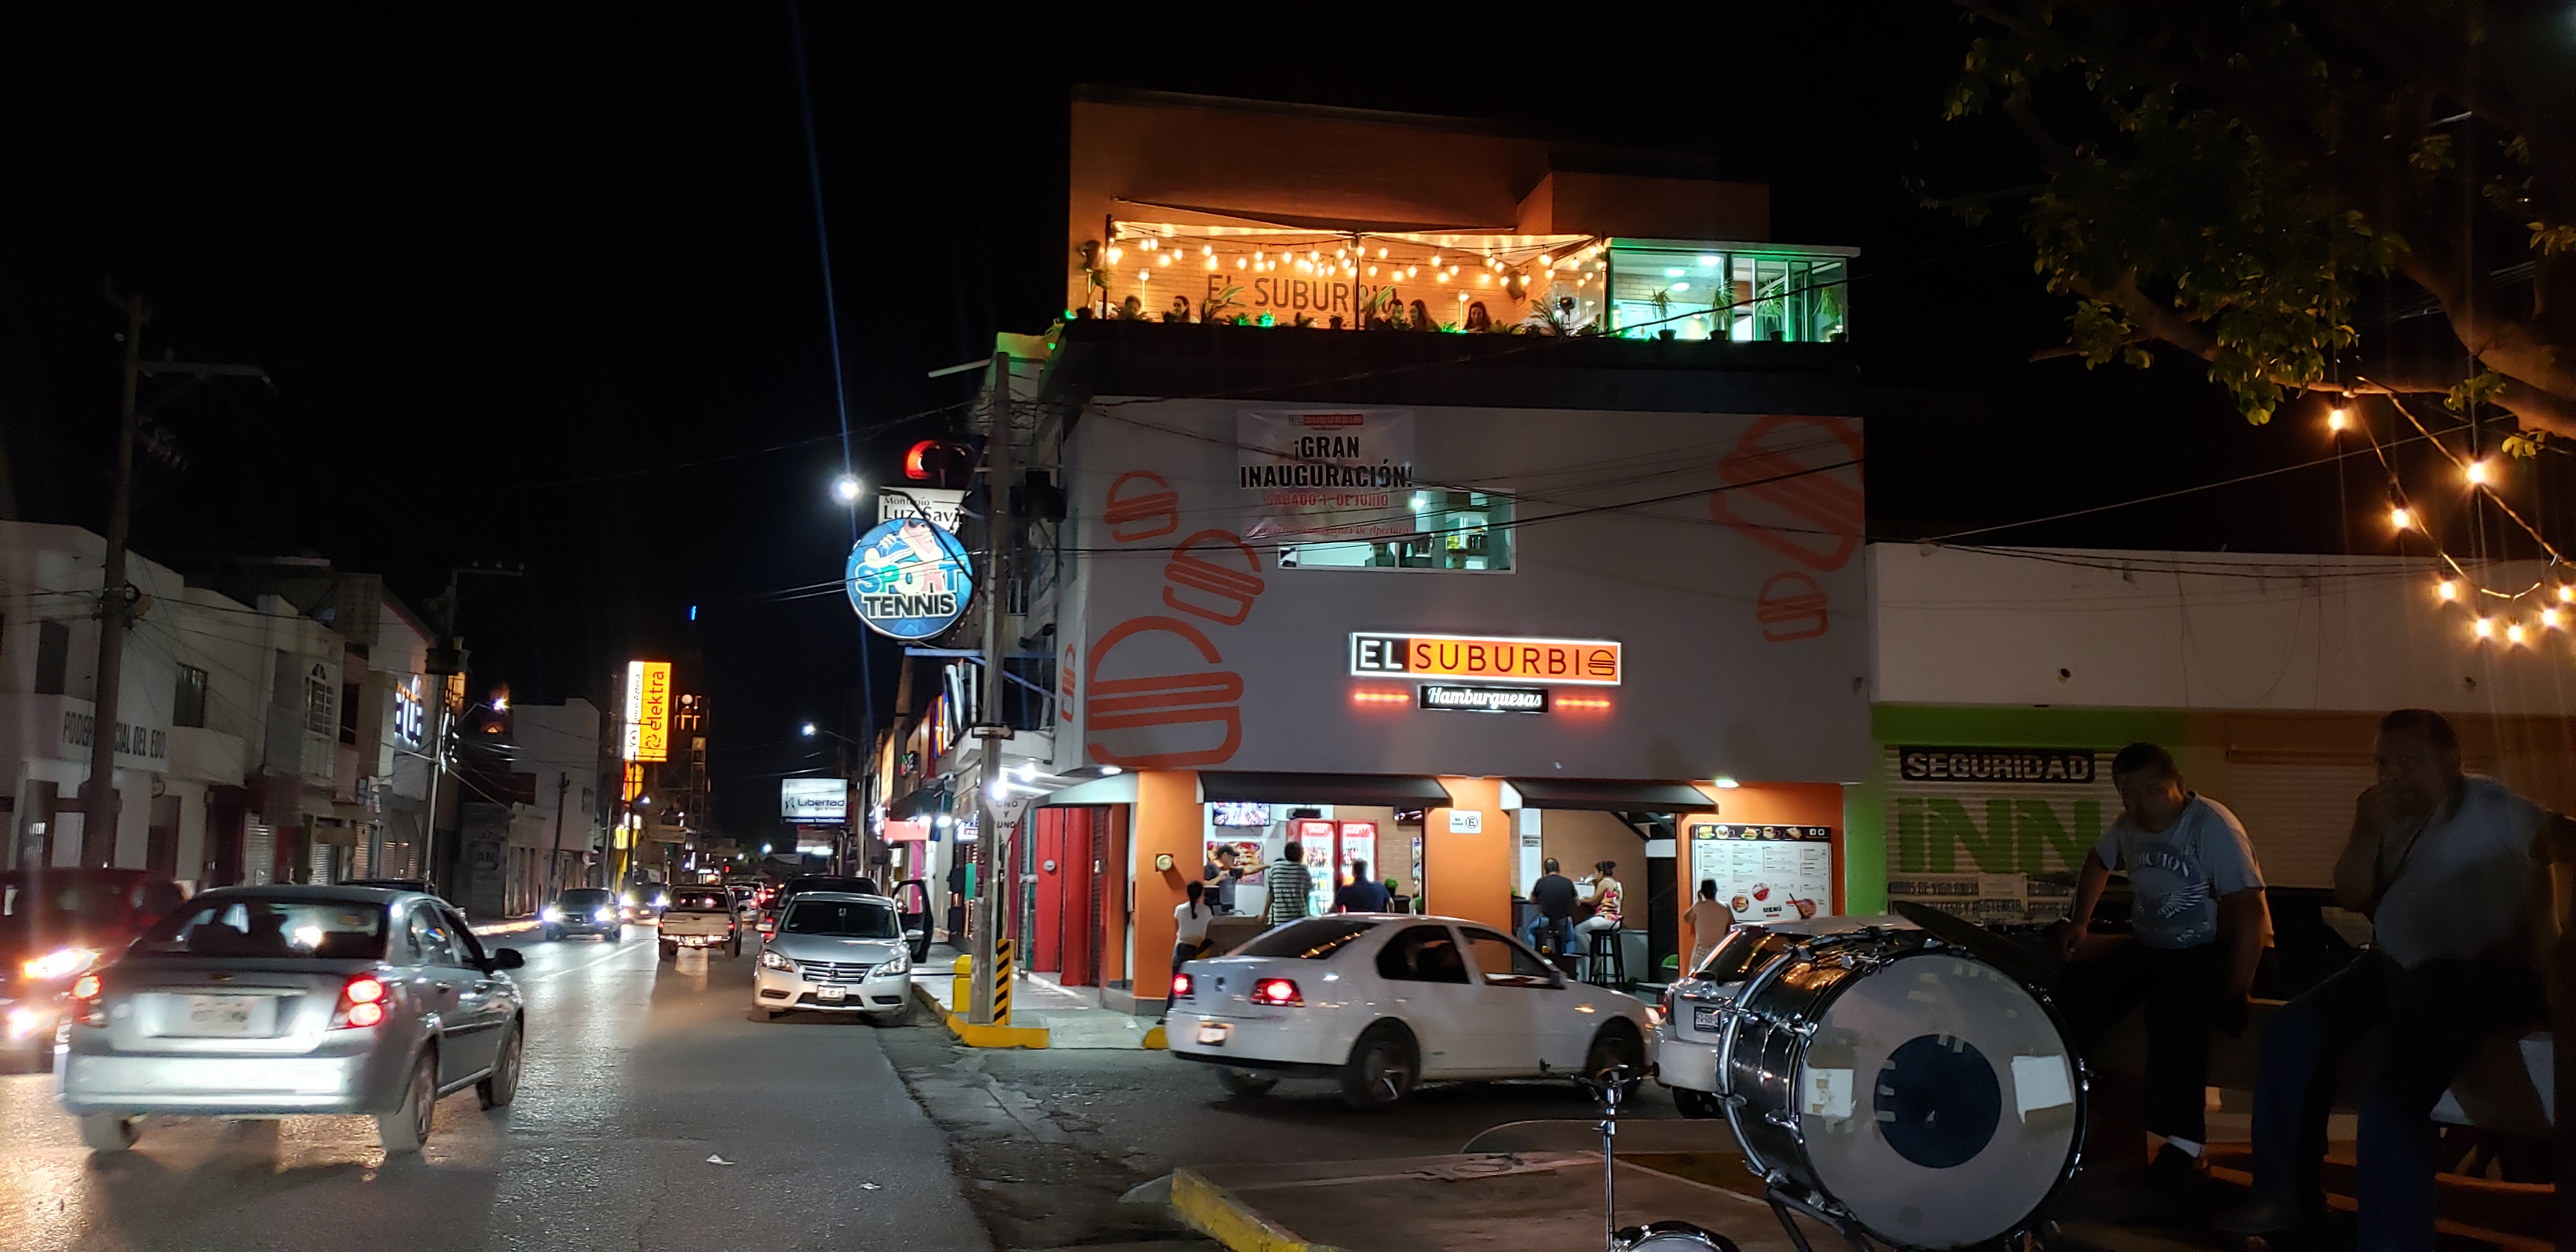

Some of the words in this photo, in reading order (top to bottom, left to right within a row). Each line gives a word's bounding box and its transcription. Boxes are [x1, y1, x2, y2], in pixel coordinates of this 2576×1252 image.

[1208, 274, 1236, 304] EL
[1294, 436, 1359, 461] ¡GRAN
[1241, 459, 1412, 488] INAUGURACIÓN!
[884, 496, 930, 506] Montpío
[1267, 492, 1316, 506] SÁBADO
[1337, 494, 1350, 506] DE
[1355, 494, 1388, 506] JUNIO
[884, 505, 916, 519] Luz
[855, 561, 964, 594] SPORT
[862, 593, 957, 618] TENNIS
[1360, 640, 1404, 670] EL
[646, 671, 664, 731] elektra
[1427, 687, 1542, 710] Hamburguesas
[1906, 752, 2089, 779] SEGURIDAD
[797, 798, 845, 806] Libertad
[997, 821, 1016, 829] UNO
[1897, 798, 2101, 874] INN
[1763, 905, 1782, 913] MENÚ
